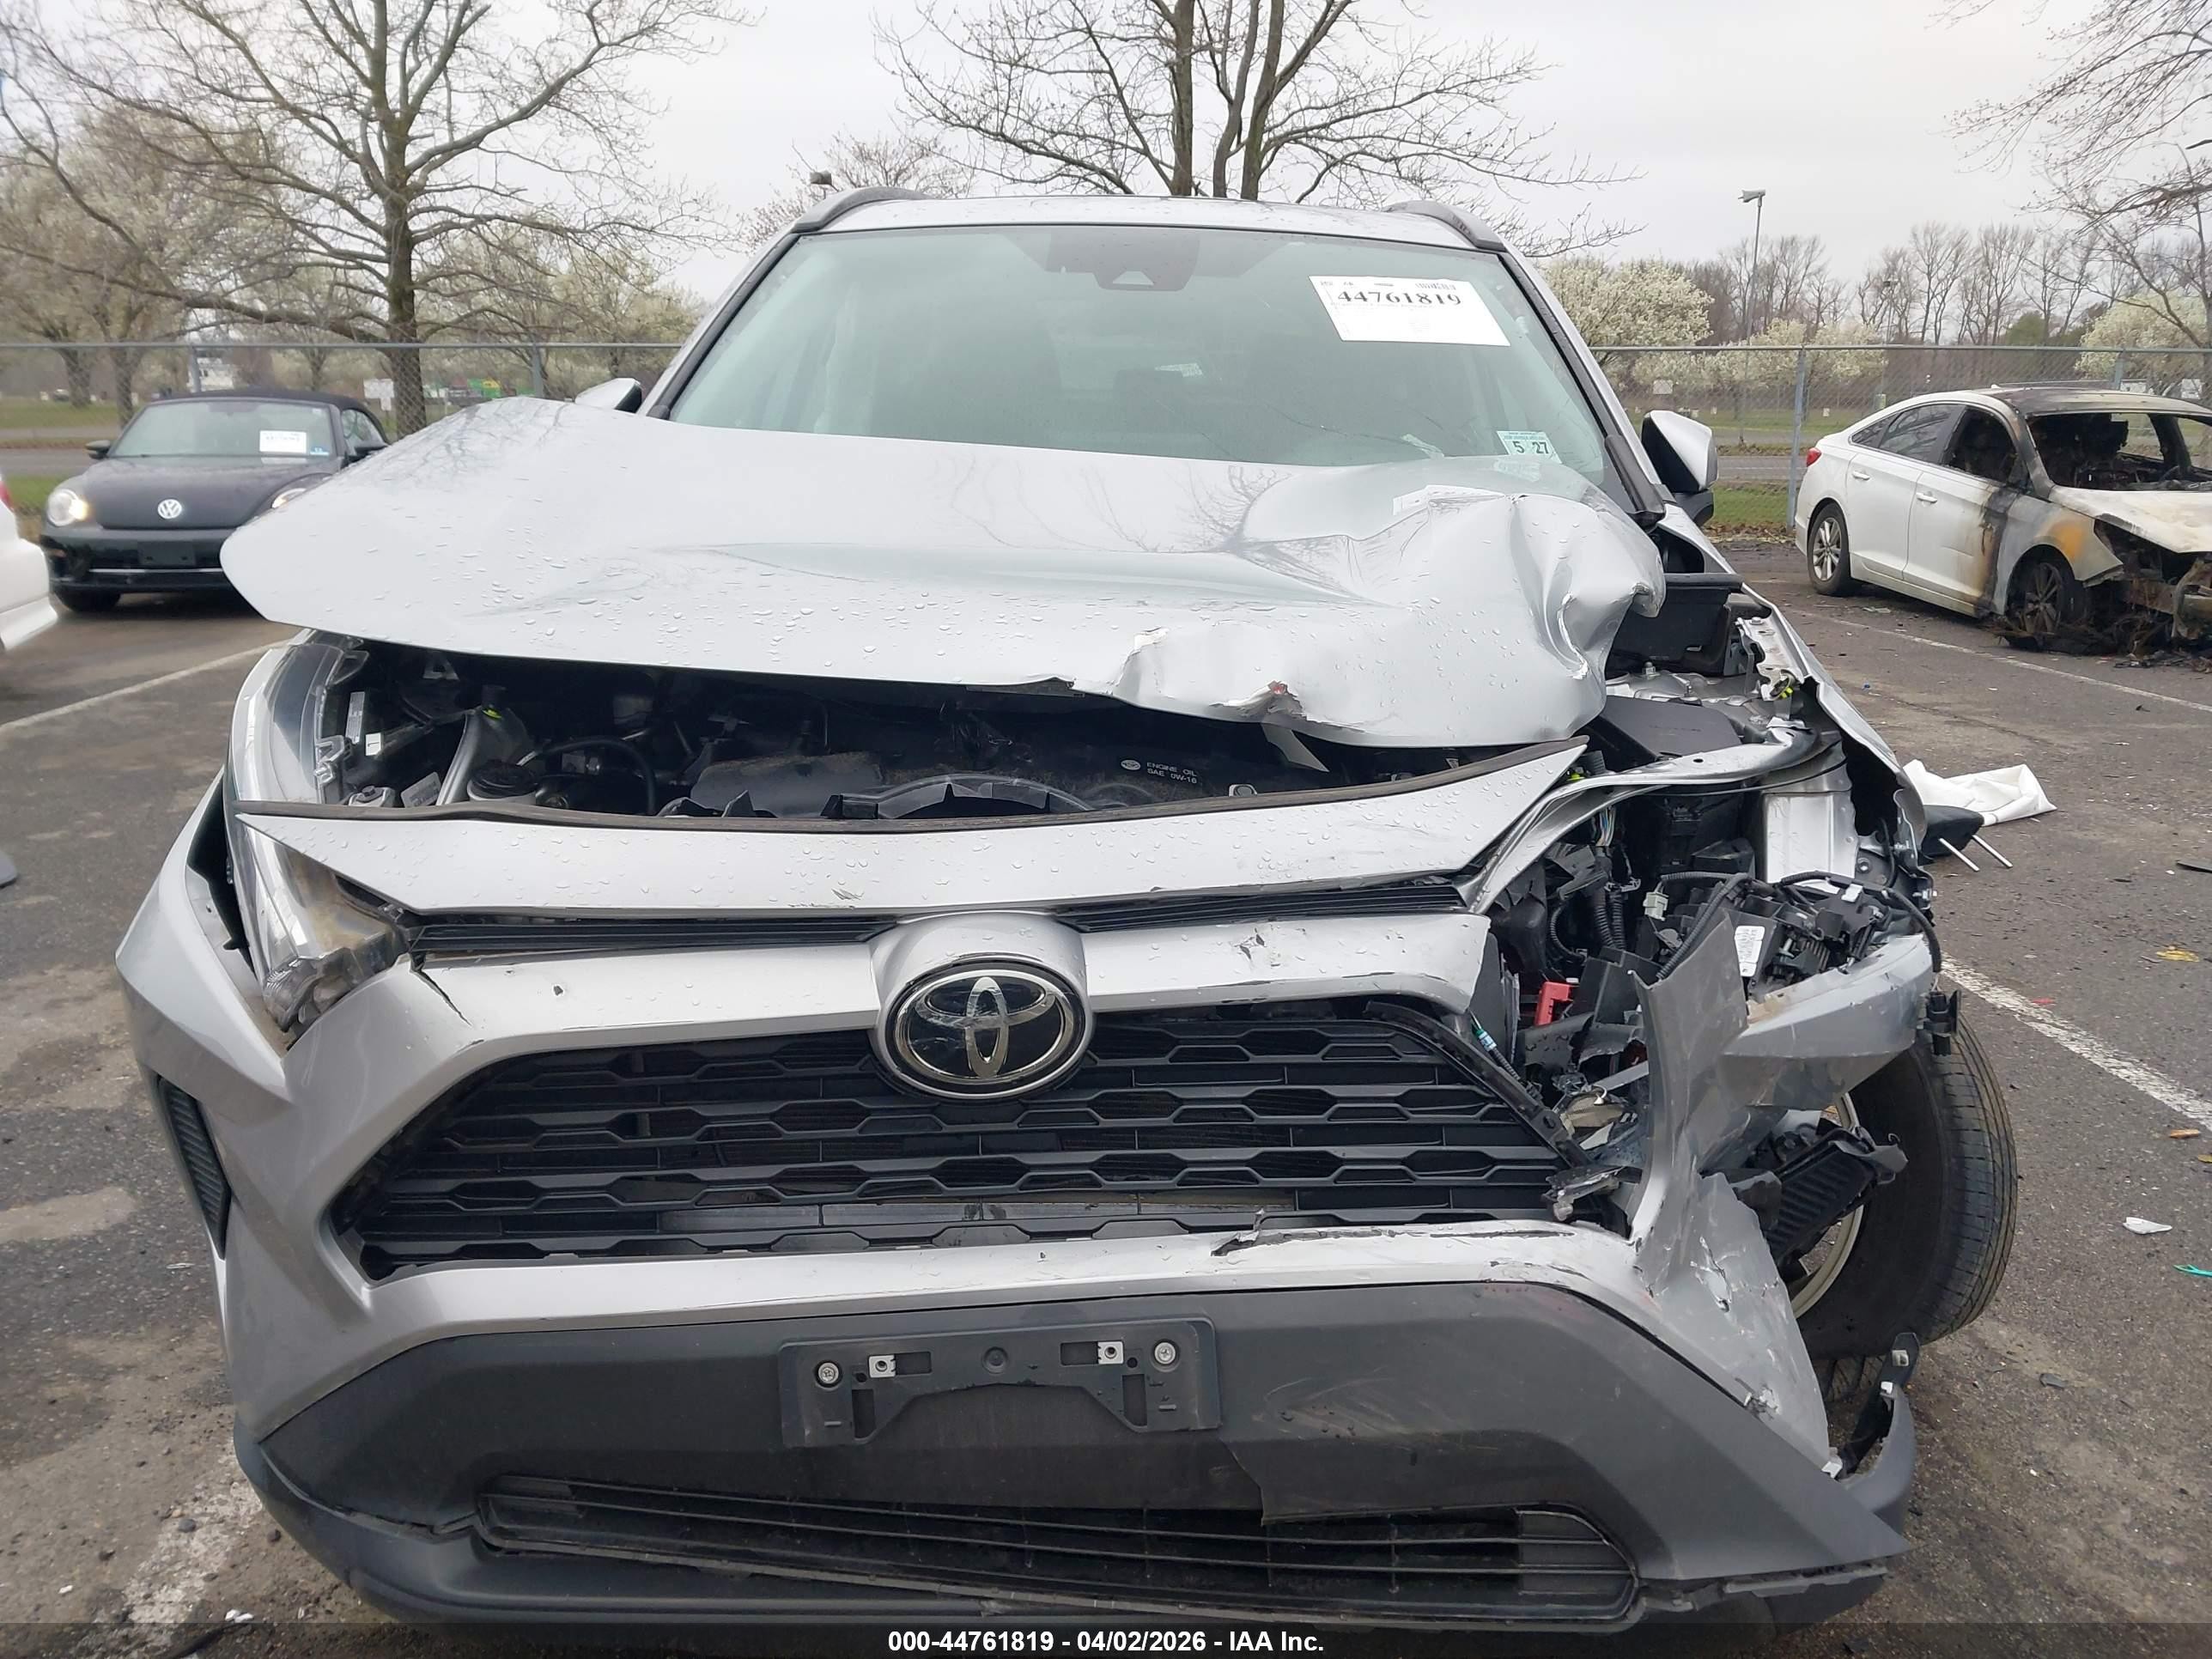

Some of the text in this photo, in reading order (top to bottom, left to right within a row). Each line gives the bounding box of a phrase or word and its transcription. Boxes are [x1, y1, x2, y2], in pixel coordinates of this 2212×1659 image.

[1338, 290, 1462, 306] 44761819
[1512, 441, 1549, 454] 5 27
[1146, 762, 1197, 777] ENGINE OIL
[1147, 768, 1165, 777] SAE
